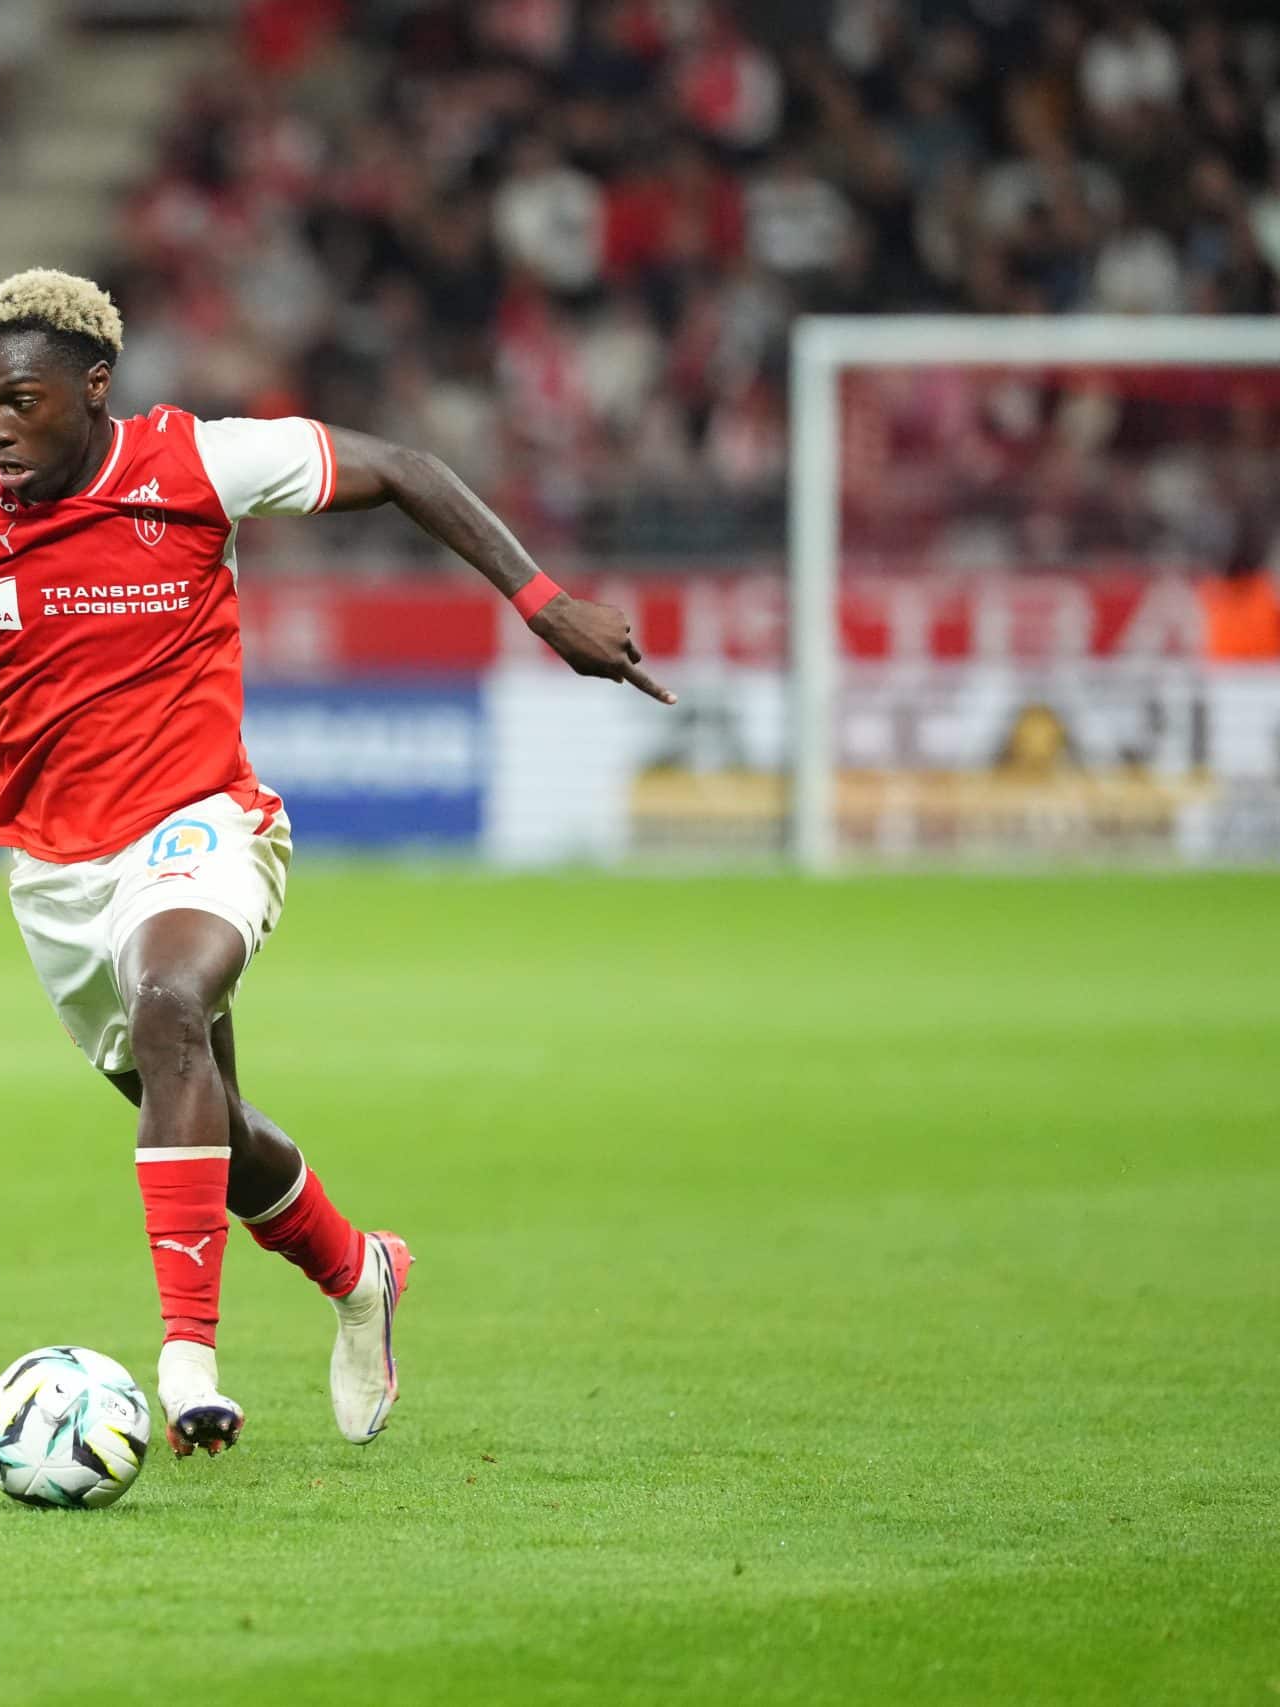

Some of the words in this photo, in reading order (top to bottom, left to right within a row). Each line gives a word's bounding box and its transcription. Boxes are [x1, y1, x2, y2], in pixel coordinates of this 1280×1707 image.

[40, 580, 190, 600] TRANSPORT
[43, 604, 60, 616] &
[62, 596, 191, 615] LOGISTIQUE
